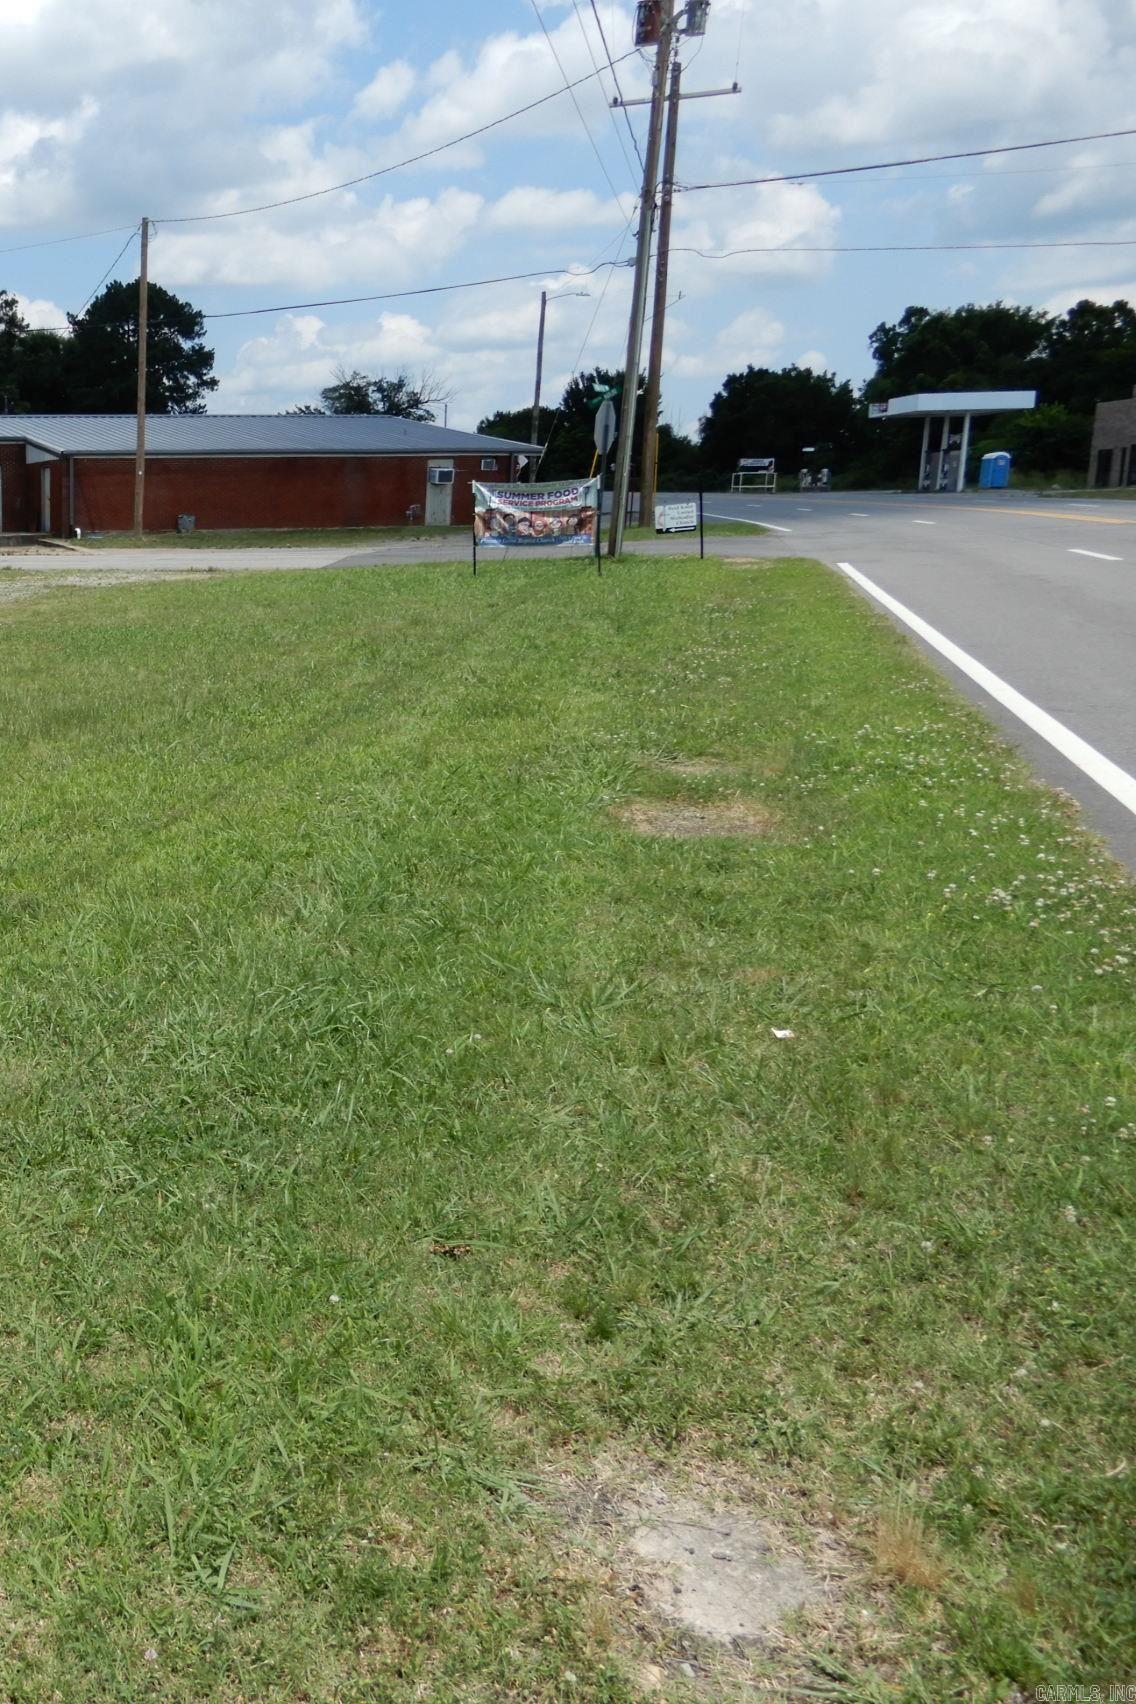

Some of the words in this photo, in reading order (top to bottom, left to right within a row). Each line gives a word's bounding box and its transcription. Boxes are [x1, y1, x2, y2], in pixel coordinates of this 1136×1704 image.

[497, 491, 545, 500] SUMMER
[547, 487, 579, 499] FOOD
[498, 499, 534, 507] SERVICE
[535, 496, 578, 507] PROGRAM
